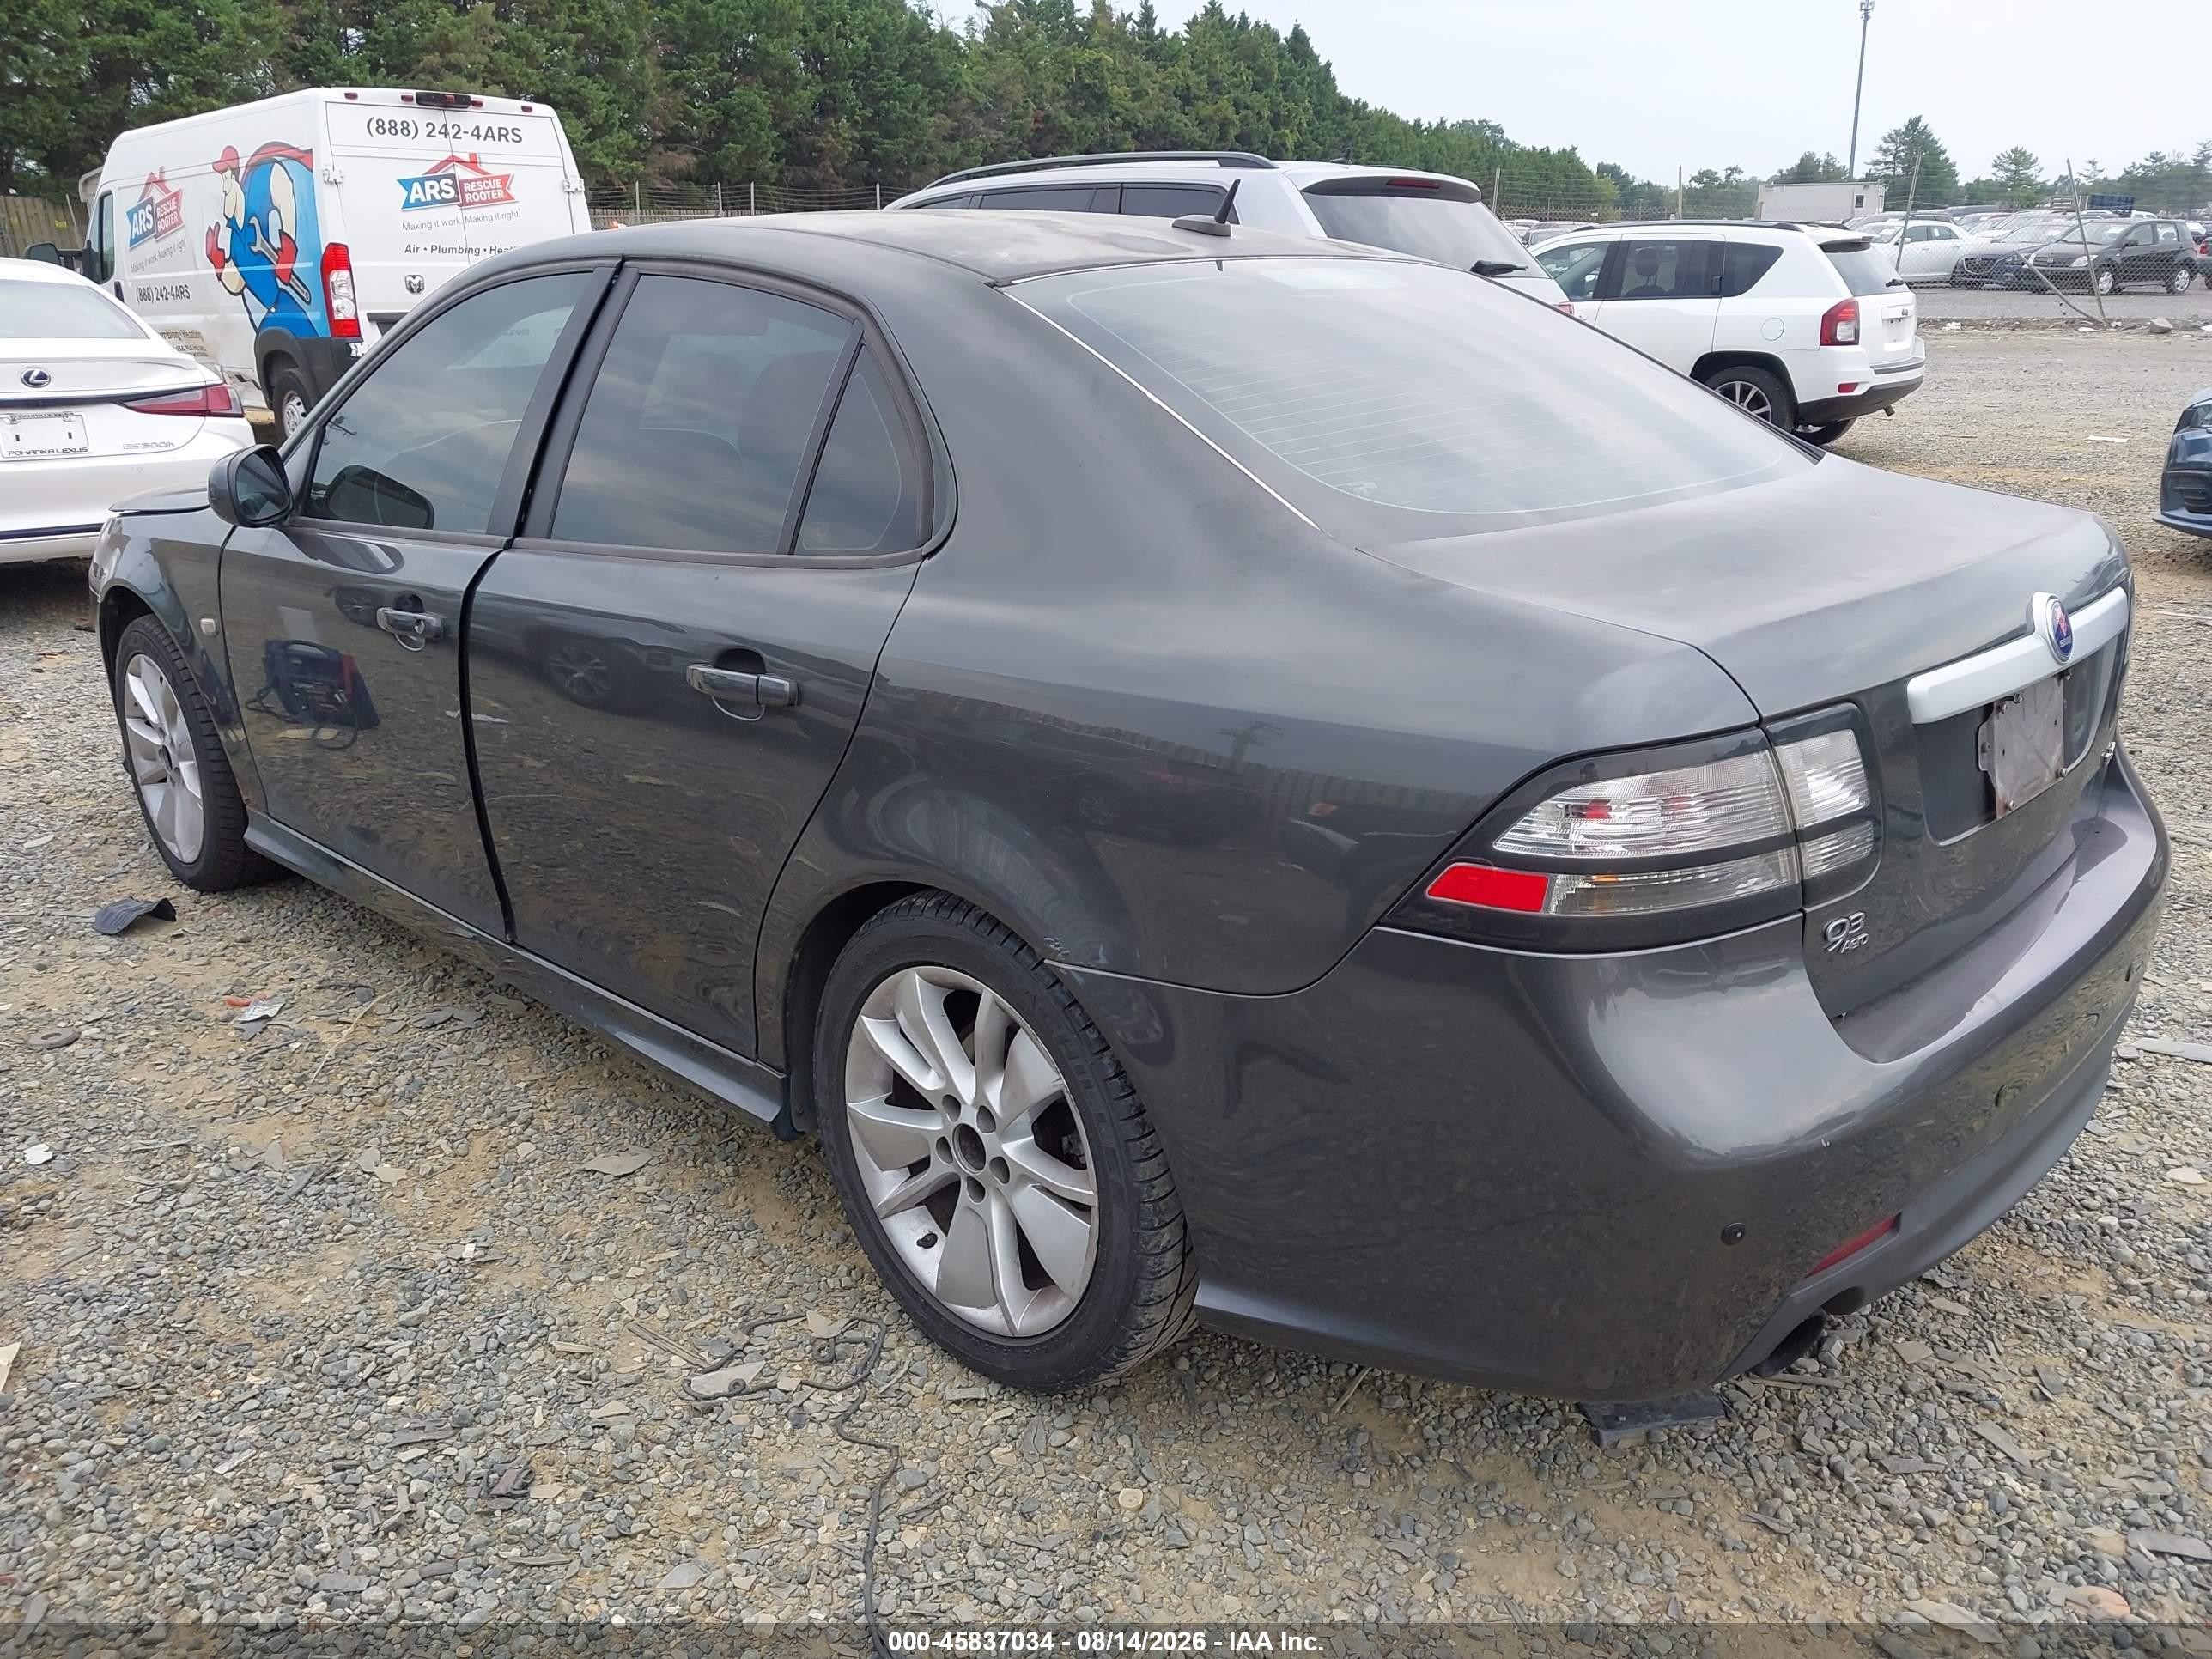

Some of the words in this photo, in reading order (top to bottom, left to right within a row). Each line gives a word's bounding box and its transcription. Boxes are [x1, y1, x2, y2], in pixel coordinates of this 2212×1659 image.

[367, 117, 419, 140] (888)
[425, 122, 523, 143] 242-4ARS
[410, 179, 456, 204] ARS
[464, 179, 501, 192] RESCUE
[465, 189, 504, 203] ROOTER
[156, 198, 178, 218] RESCUE
[131, 204, 154, 239] ARS
[157, 211, 179, 233] ROOTER
[402, 221, 433, 231] Making
[465, 213, 494, 223] Making
[404, 244, 421, 253] Air
[430, 245, 481, 256] Plumbing
[136, 286, 154, 303] (888)
[155, 284, 191, 301] 242-4ARS
